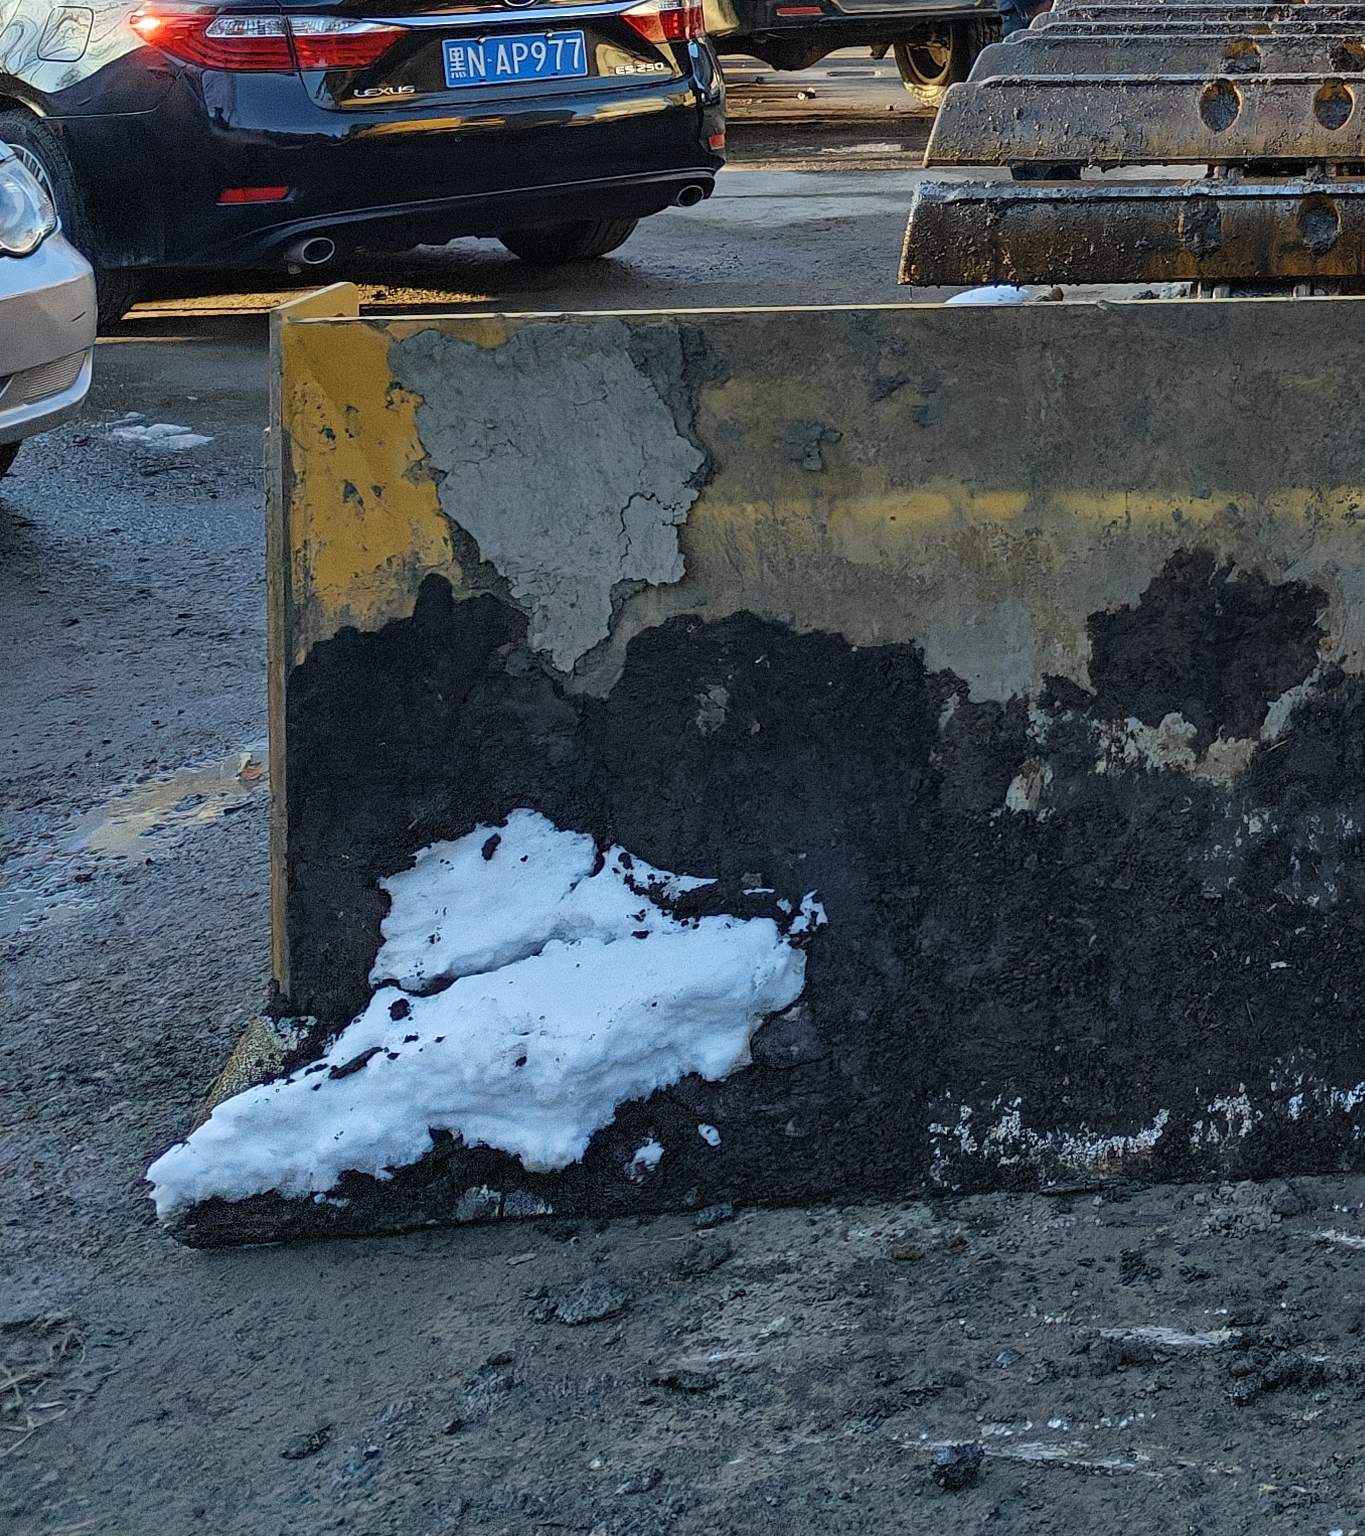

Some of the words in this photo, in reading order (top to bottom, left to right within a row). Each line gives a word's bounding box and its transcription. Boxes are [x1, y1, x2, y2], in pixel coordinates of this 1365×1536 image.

[615, 65, 635, 75] ES
[636, 62, 665, 73] 250
[353, 85, 416, 98] LEXUS
